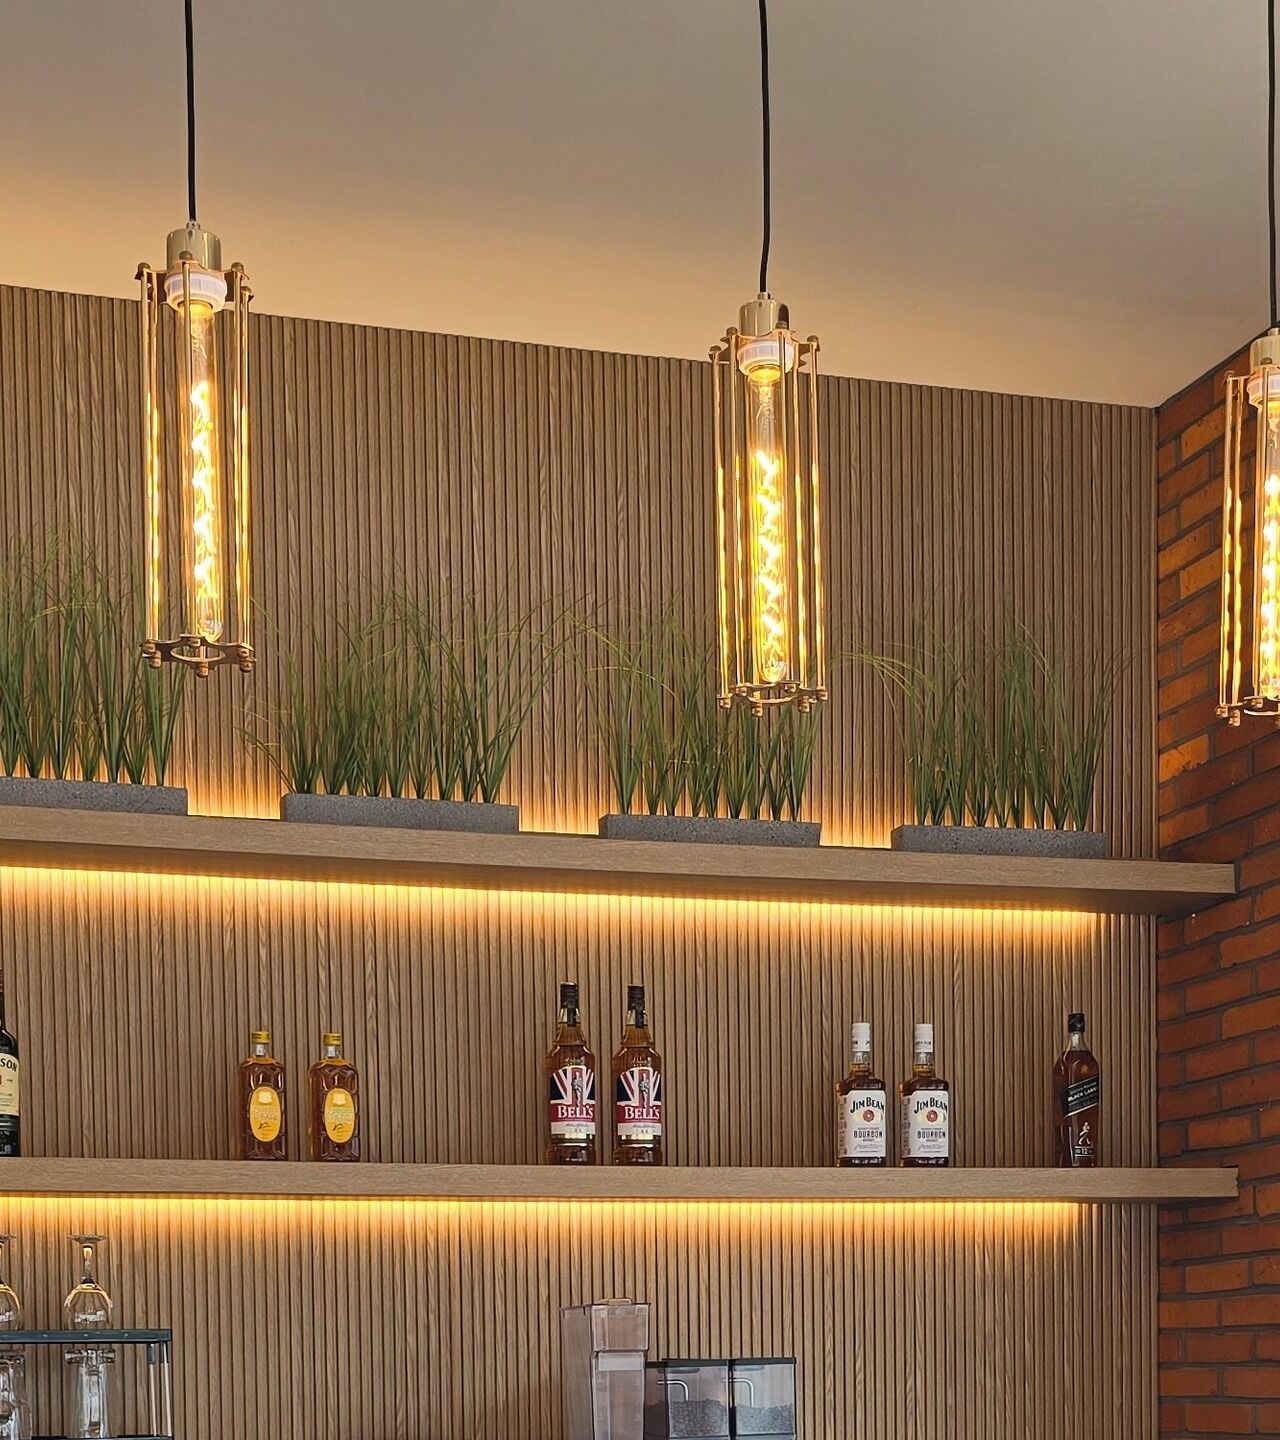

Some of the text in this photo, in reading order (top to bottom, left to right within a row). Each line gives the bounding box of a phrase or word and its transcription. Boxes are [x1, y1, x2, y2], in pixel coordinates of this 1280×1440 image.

[557, 1105, 594, 1118] BELL'S
[625, 1106, 660, 1120] BELL'S
[850, 1099, 865, 1113] JIM
[914, 1100, 929, 1114] JIM
